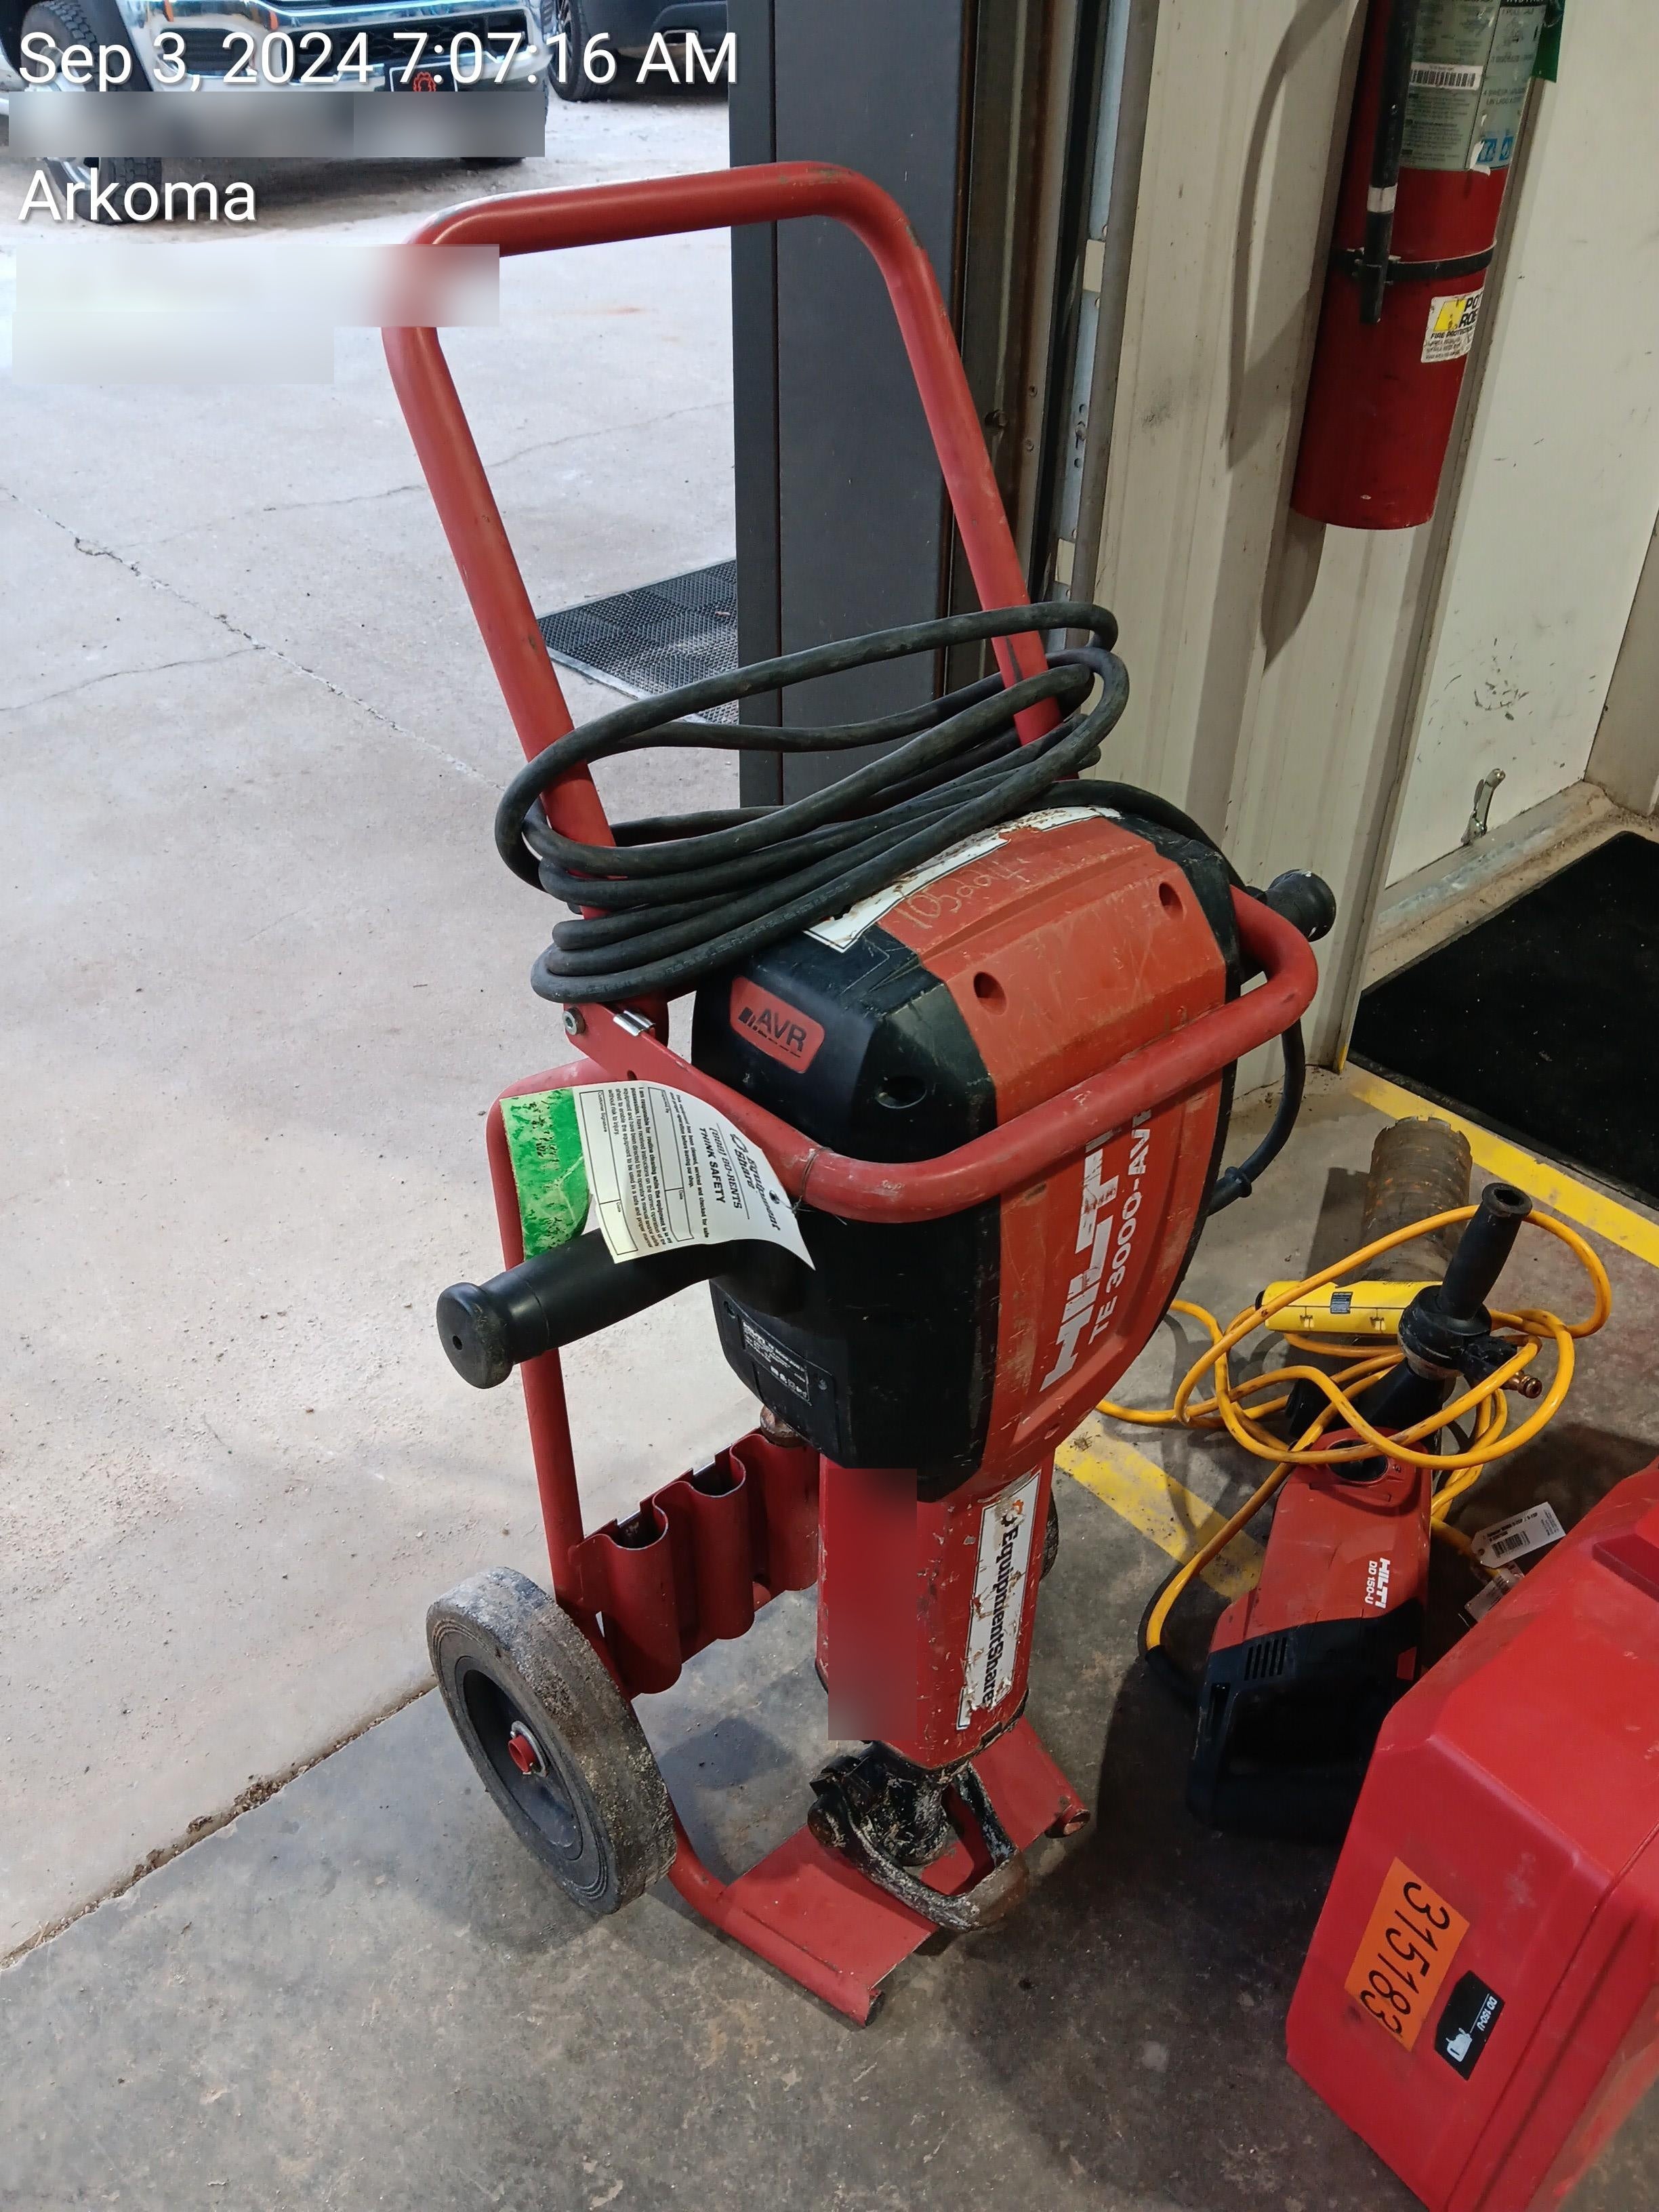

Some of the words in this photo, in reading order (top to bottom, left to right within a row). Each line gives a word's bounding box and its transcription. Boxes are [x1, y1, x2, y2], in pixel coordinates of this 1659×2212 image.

[757, 1008, 806, 1052] AVR
[607, 1088, 615, 1106] without
[638, 1090, 644, 1098] am
[600, 1111, 608, 1132] Signature
[640, 1098, 650, 1126] responsible
[622, 1087, 632, 1111] equipment
[632, 1144, 640, 1164] directed
[641, 1201, 649, 1220] manual
[646, 1135, 655, 1153] routine
[676, 1113, 686, 1134] operation
[683, 1149, 691, 1166] leaving
[687, 1174, 695, 1187] shop.
[640, 1150, 650, 1176] instructions
[648, 1153, 658, 1175] cleaning
[699, 1127, 716, 1159] THINK
[709, 1160, 726, 1203] SAFETY
[734, 1148, 755, 1189] Share
[621, 1132, 631, 1158] equipment
[636, 1216, 645, 1231] proper
[652, 1175, 660, 1189] while
[693, 1166, 701, 1185] serviced
[698, 1196, 706, 1217] checked
[745, 1155, 781, 1230] Equipment
[647, 1193, 655, 1211] correct
[655, 1199, 665, 1226] equipment
[650, 1211, 661, 1233] operation
[1040, 1127, 1120, 1392] HILTI
[1088, 1295, 1118, 1345] TE
[1368, 1560, 1378, 1575] DD
[1364, 1576, 1376, 1604] 150-U
[1375, 1557, 1391, 1608] HILTI
[983, 1525, 1019, 1704] EquipmentShare
[1359, 1881, 1450, 2034] 315183
[1486, 1996, 1498, 2010] DD
[1477, 2008, 1492, 2031] 150-U
